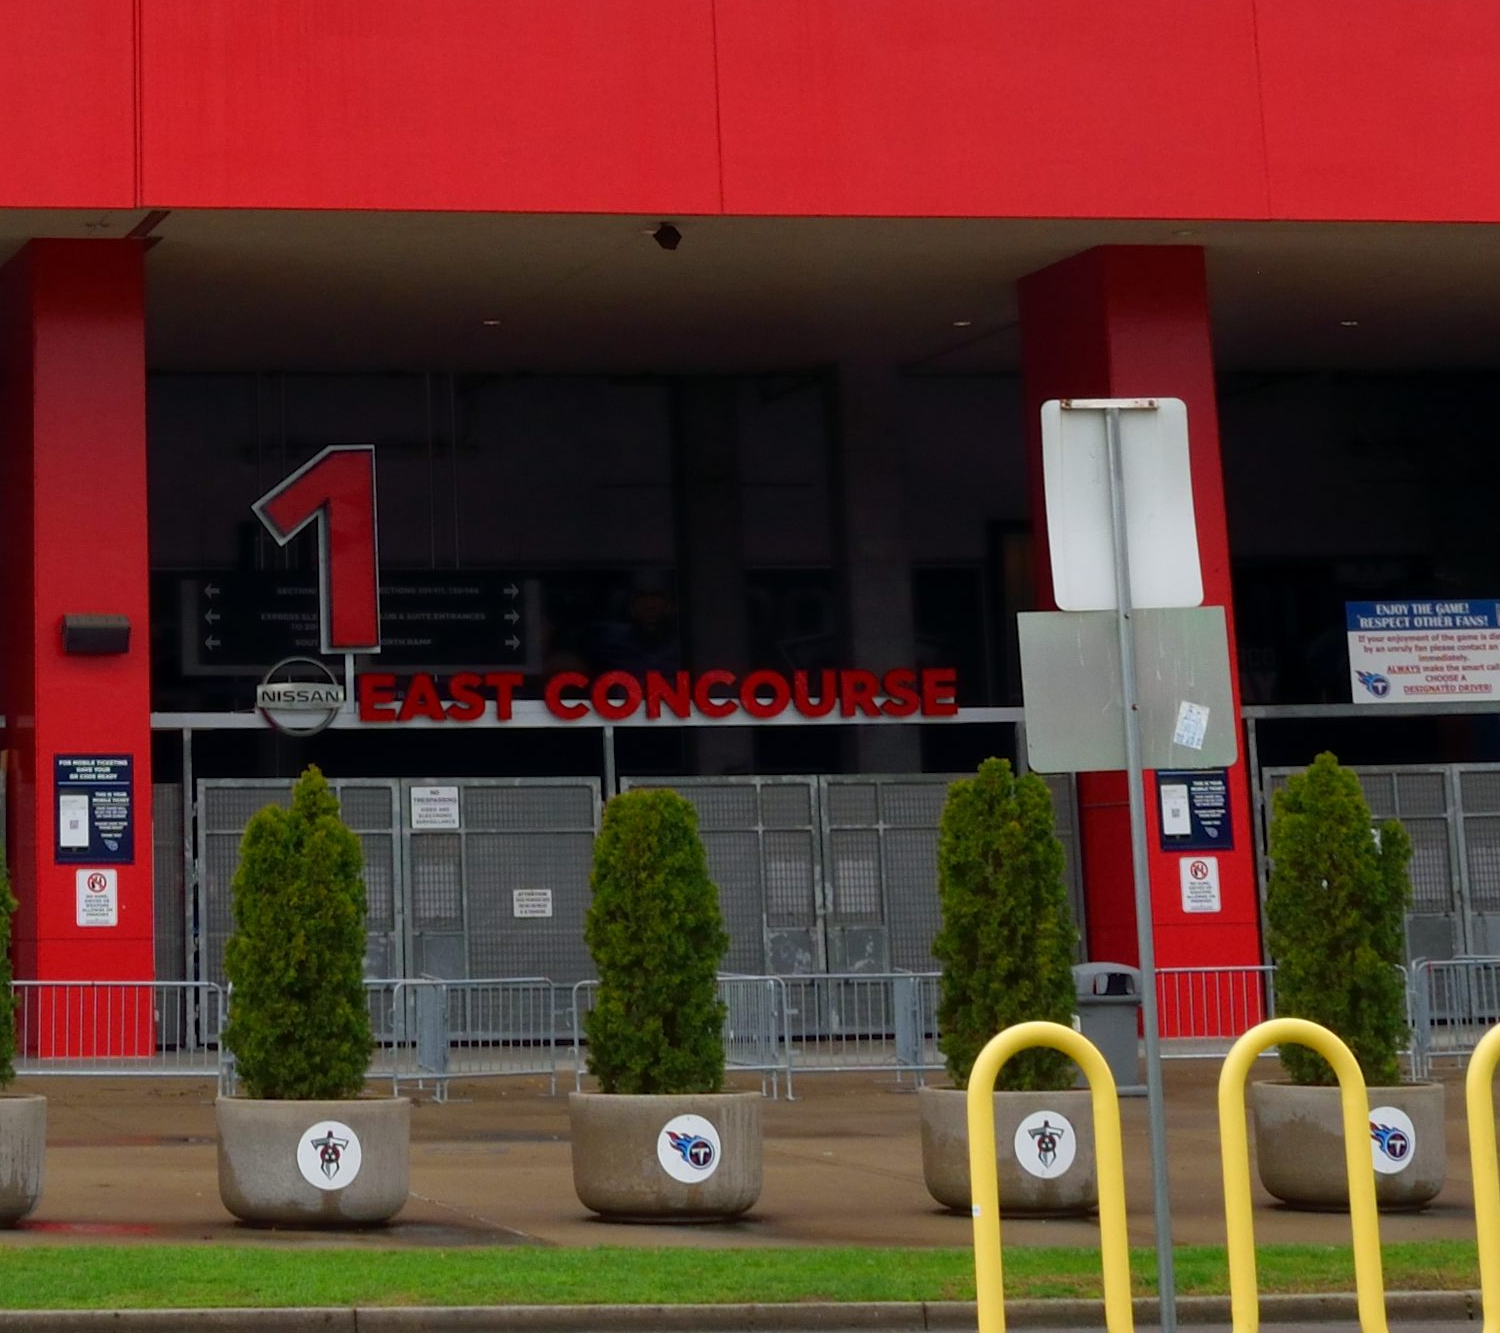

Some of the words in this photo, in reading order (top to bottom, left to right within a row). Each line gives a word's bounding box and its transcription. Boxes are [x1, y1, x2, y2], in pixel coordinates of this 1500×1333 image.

[251, 444, 381, 655] 1
[1376, 604, 1410, 615] ENJOY
[1412, 604, 1433, 615] THE
[1437, 603, 1469, 614] GAME!
[1360, 617, 1410, 628] RESPECT
[1414, 616, 1452, 627] OTHER
[1456, 615, 1488, 627] FANS!
[1367, 636, 1384, 644] your
[1387, 634, 1429, 643] enjoyment
[1457, 634, 1479, 642] game
[1387, 645, 1412, 653] unruly
[1430, 644, 1455, 652] please
[1387, 666, 1420, 674] ALWAYS
[1425, 674, 1459, 682] CHOOSE
[1461, 674, 1467, 682] A
[359, 671, 524, 723] EAST
[543, 666, 959, 721] CONCOURSE
[1404, 685, 1456, 695] DESIGNATED
[1459, 684, 1492, 693] DRIVER!
[261, 690, 339, 703] NISSAN
